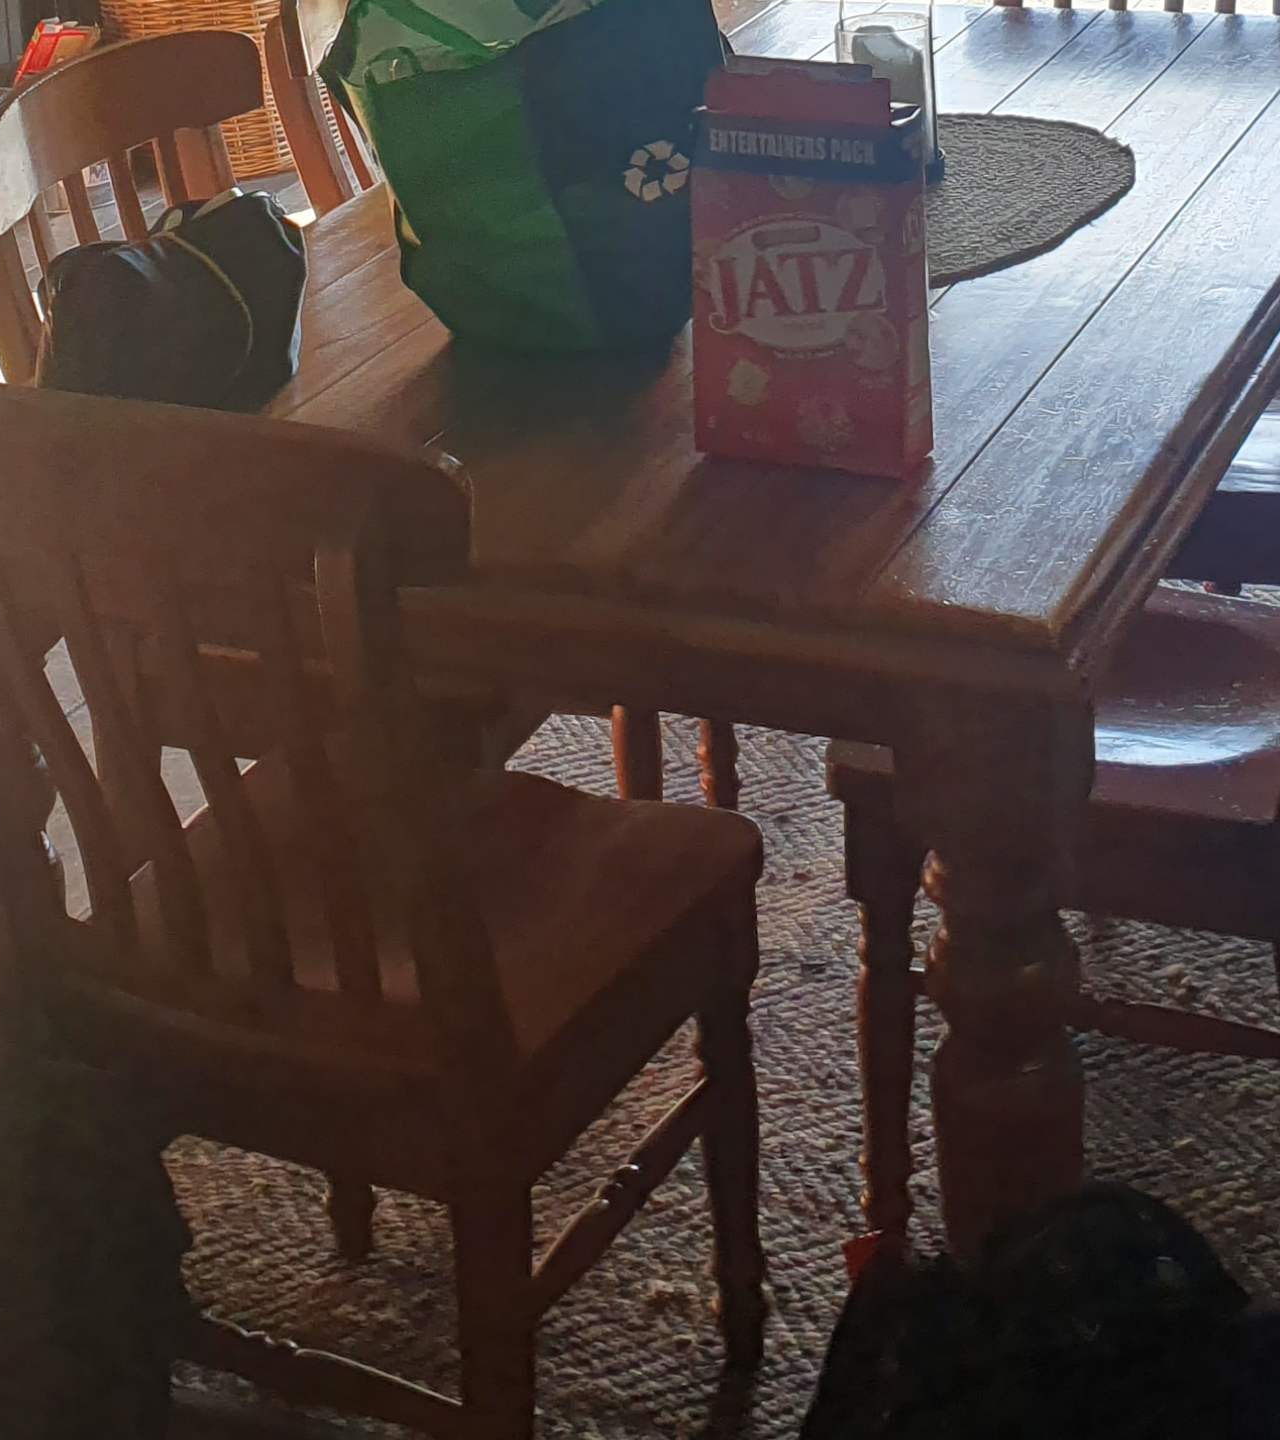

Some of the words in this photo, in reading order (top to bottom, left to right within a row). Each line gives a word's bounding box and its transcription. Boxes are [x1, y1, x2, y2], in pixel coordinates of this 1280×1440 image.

[709, 127, 825, 160] ENTERTAINERS
[830, 136, 876, 165] PACK
[709, 245, 886, 333] JATZ
